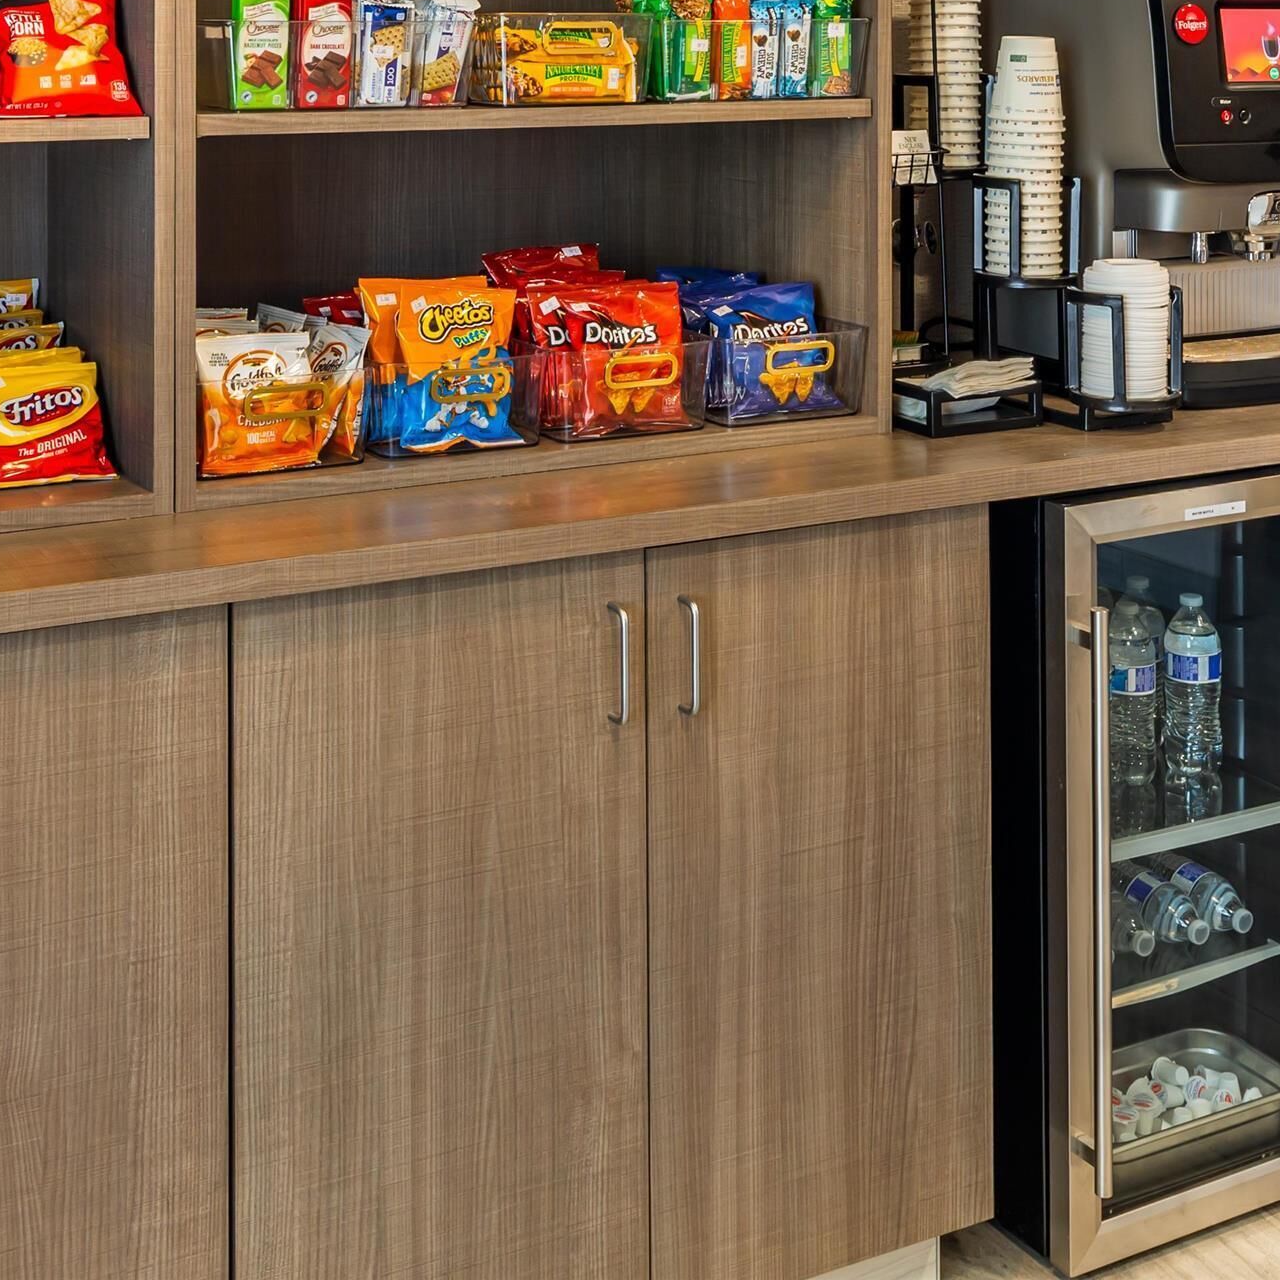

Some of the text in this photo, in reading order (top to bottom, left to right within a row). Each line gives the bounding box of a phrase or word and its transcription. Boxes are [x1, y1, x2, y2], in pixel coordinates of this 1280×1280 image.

[4, 14, 41, 27] KETTLE
[10, 22, 44, 36] CORN
[1178, 20, 1207, 31] Folgers
[757, 49, 766, 79] CHEWY
[790, 44, 798, 74] CHEWY
[546, 64, 576, 79] NATURE
[419, 299, 494, 343] Cheetos
[734, 317, 809, 342] Doritos
[454, 328, 488, 348] Puffs
[585, 322, 657, 345] Doritos
[0, 386, 83, 425] Fritos
[18, 429, 87, 457] The ORIGINAL
